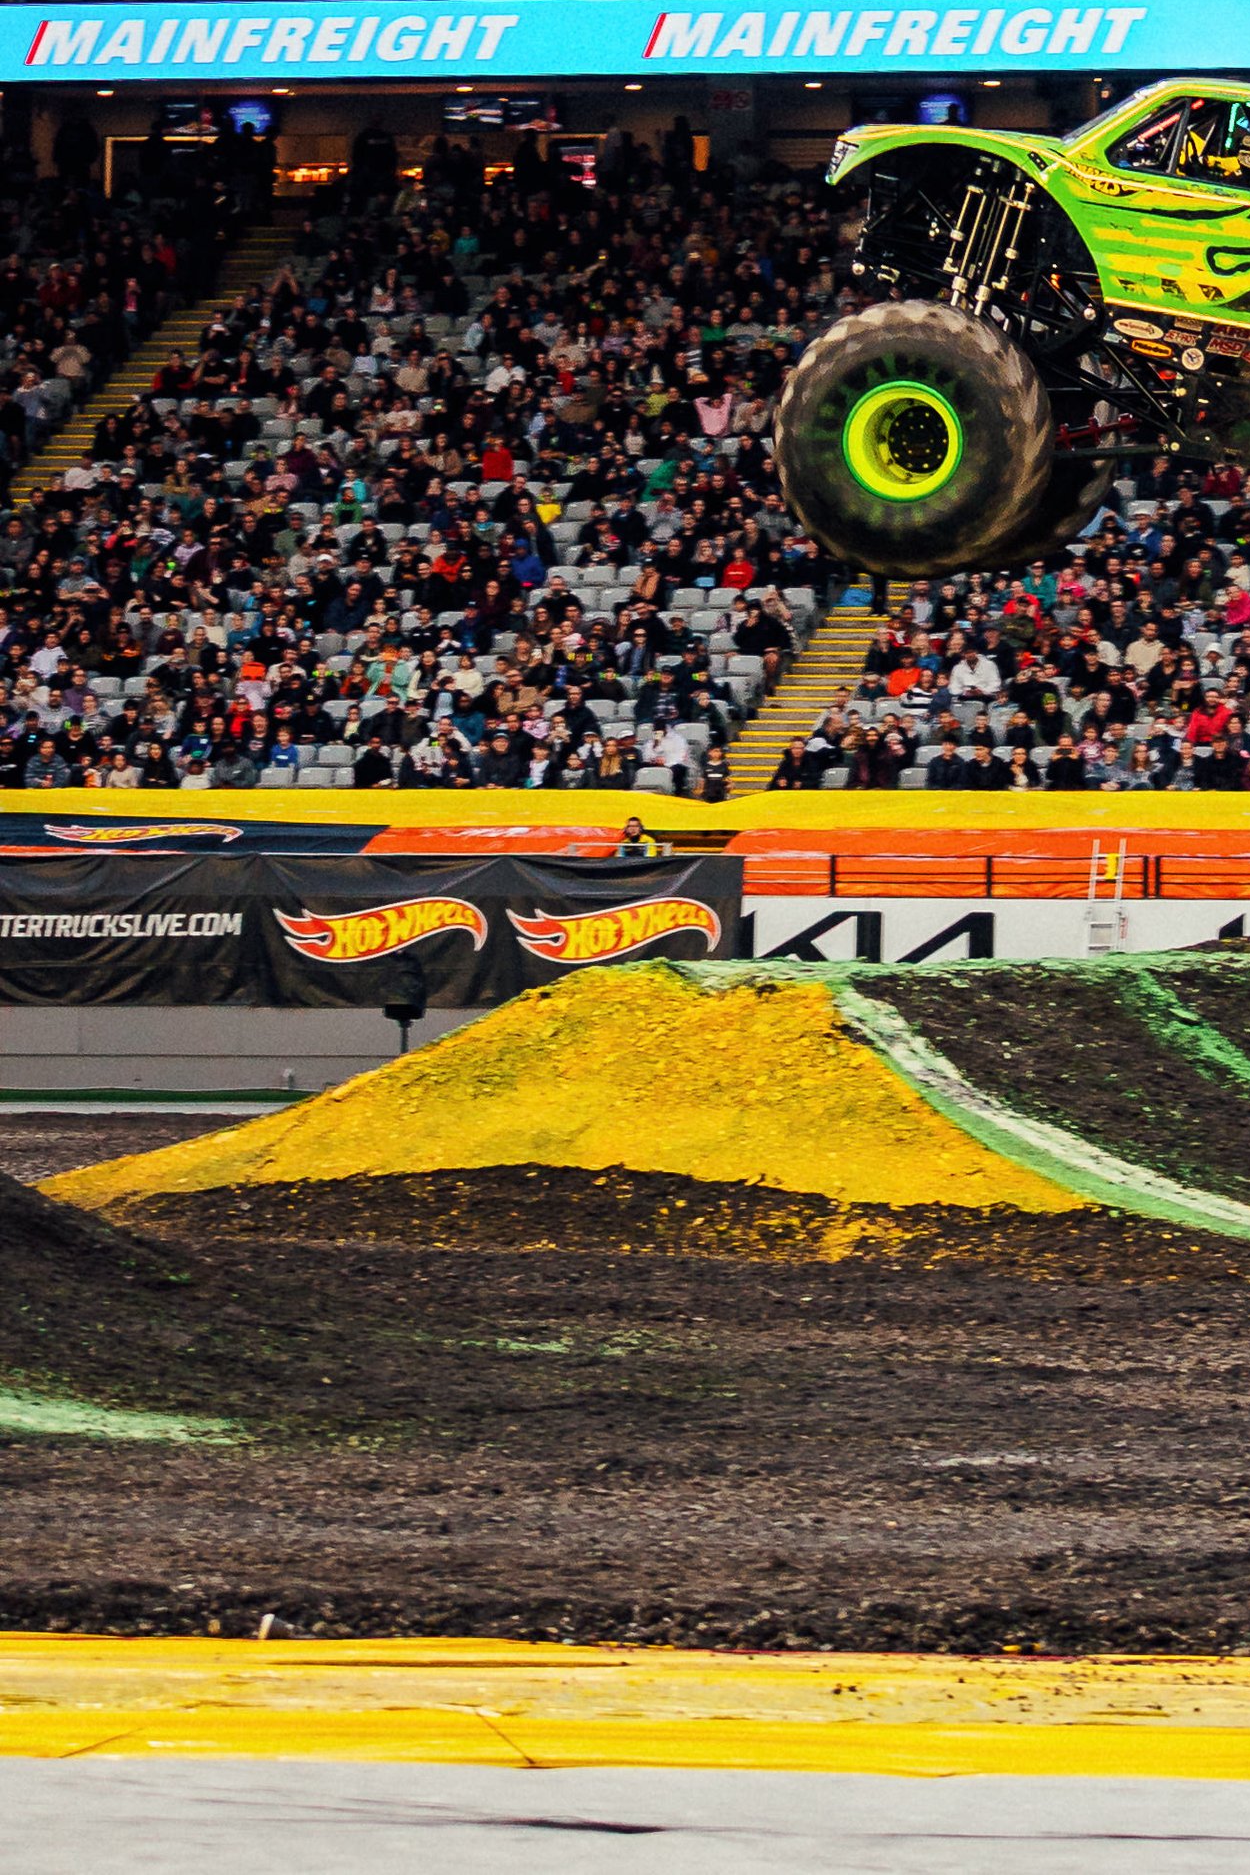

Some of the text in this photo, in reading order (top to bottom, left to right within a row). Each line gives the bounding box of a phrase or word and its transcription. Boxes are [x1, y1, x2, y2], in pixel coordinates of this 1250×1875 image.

[26, 15, 520, 66] MAINFREIGHT
[643, 8, 1148, 60] MAINFREIGHT
[1209, 336, 1246, 353] MSD
